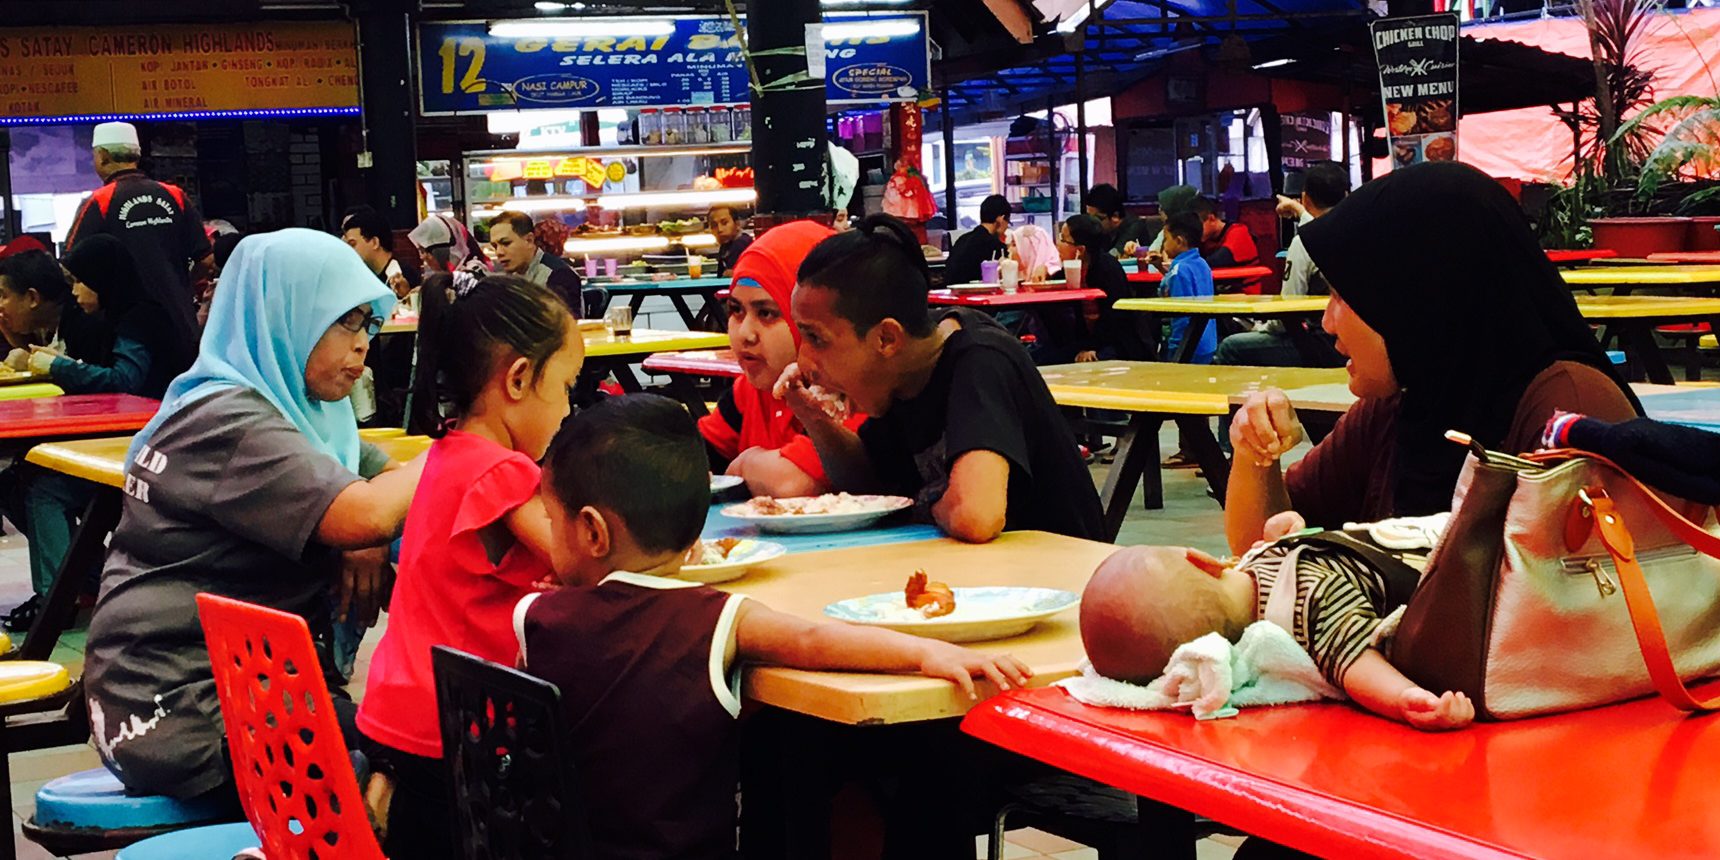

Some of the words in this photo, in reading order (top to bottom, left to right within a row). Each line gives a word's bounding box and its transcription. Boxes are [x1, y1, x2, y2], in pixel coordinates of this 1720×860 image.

[20, 36, 73, 57] SATAY
[88, 34, 173, 56] CAMERON
[183, 31, 273, 53] HIGHLANDS
[1375, 27, 1423, 50] CHICKEN
[1425, 25, 1456, 42] CHOP
[560, 53, 658, 66] SELERA
[667, 52, 716, 63] ALA
[824, 48, 857, 58] NG
[438, 36, 487, 94] 12
[848, 68, 892, 77] SPECIAL
[142, 79, 158, 90] AIR
[164, 79, 196, 90] BOTOL
[245, 76, 289, 88] TONGKAT
[521, 83, 548, 92] NASI
[551, 80, 588, 91] CAMPUR
[1383, 84, 1414, 98] NEW
[1417, 81, 1455, 96] MENU
[8, 101, 41, 113] KOTAK
[143, 97, 159, 109] AIR
[164, 96, 208, 108] MINERAL
[118, 195, 153, 220] HIGHLANDS
[156, 197, 174, 215] SATAY
[133, 444, 168, 475] LD
[122, 472, 150, 503] ER
